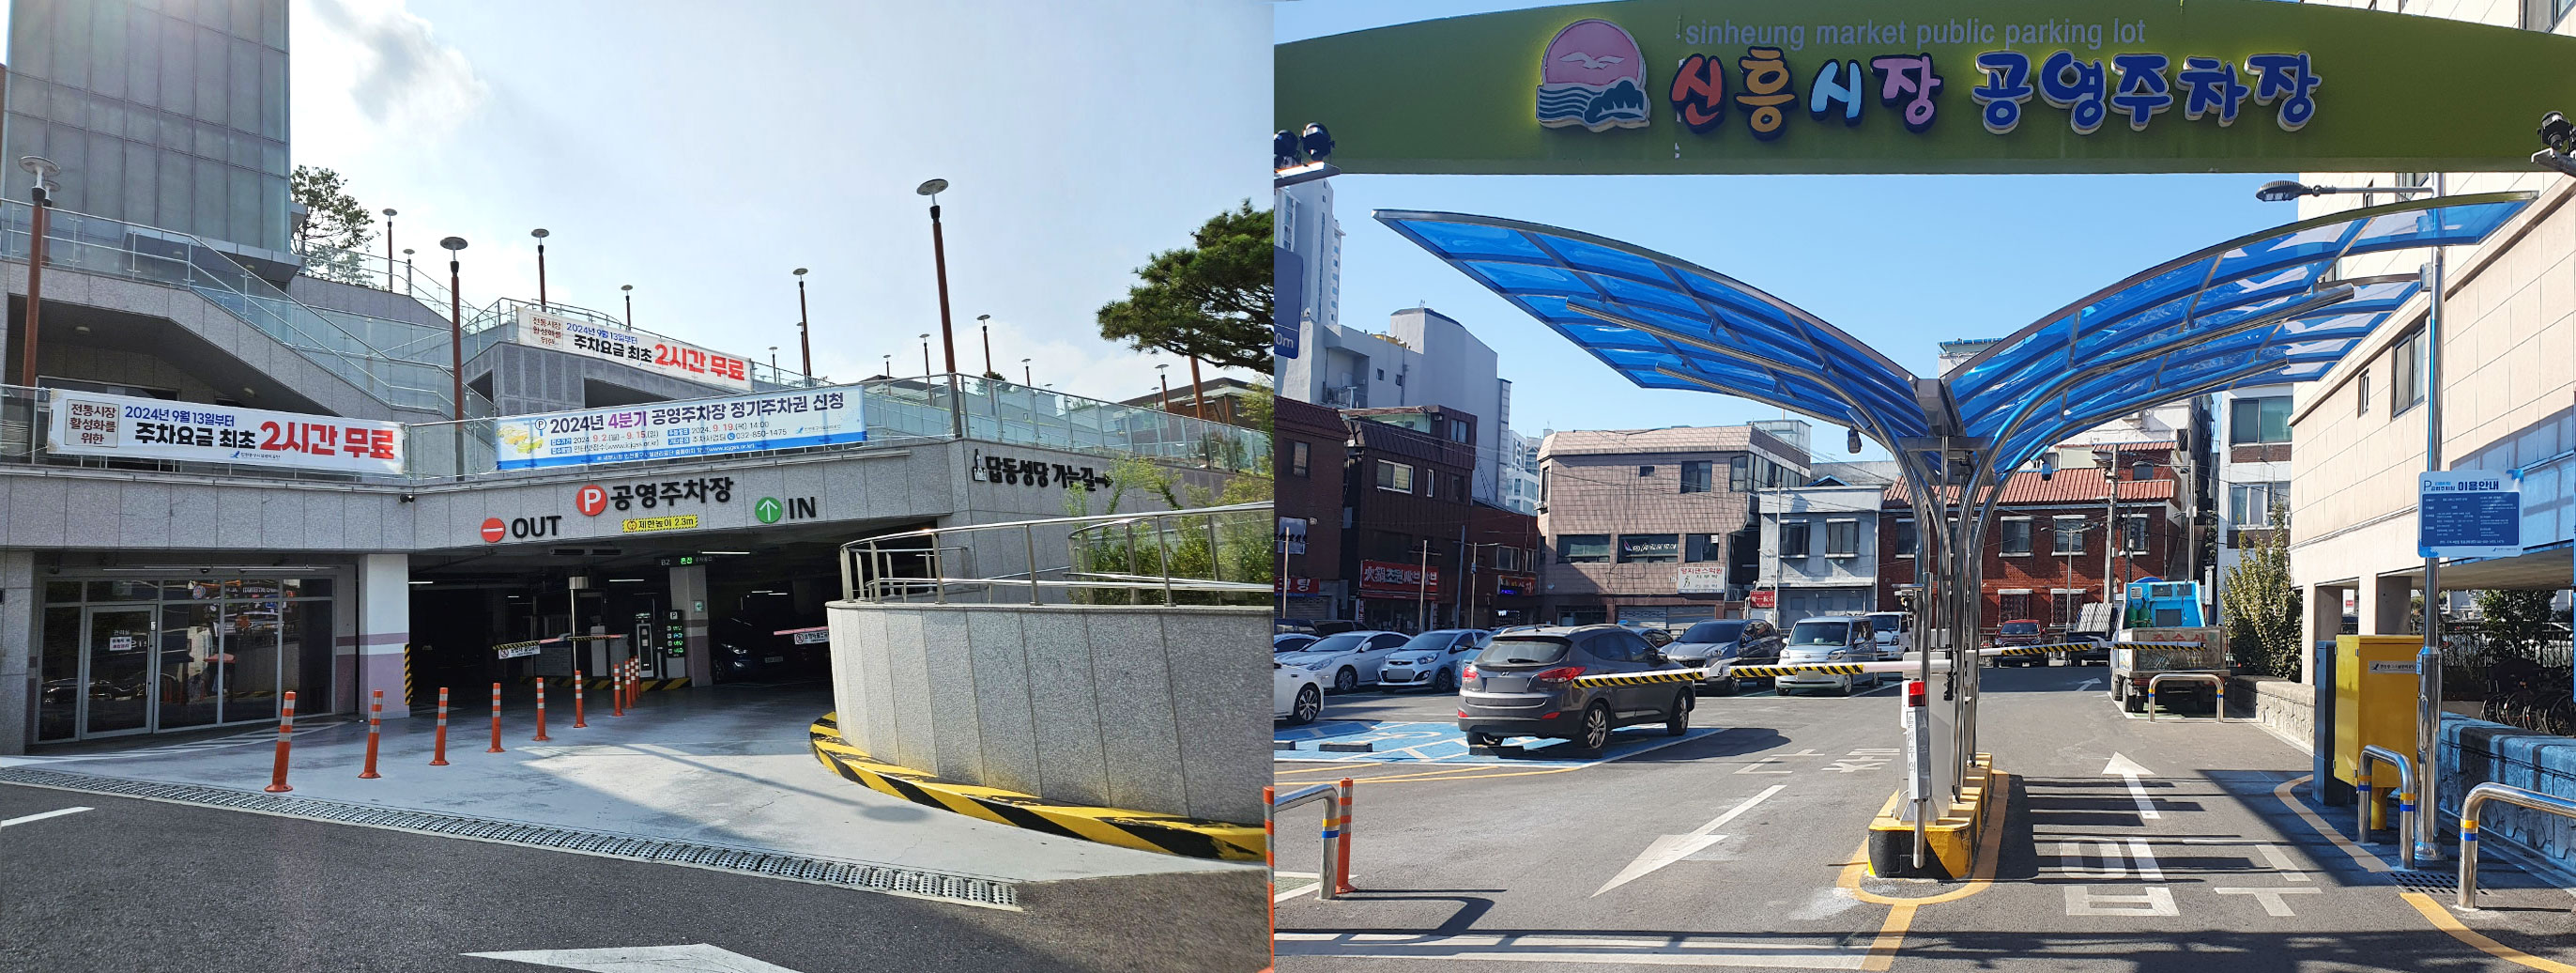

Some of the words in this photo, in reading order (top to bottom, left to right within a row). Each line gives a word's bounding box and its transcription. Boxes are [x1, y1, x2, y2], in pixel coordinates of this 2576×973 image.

[1685, 19, 1805, 51] sinheung
[1816, 20, 1907, 45] market
[1916, 19, 1995, 50] public
[2005, 18, 2103, 50] parking
[2113, 18, 2146, 43] lot
[1670, 47, 1943, 141] 신흥시장
[1972, 50, 2322, 134] 공영주차장
[532, 317, 561, 331] 전통시장
[566, 322, 595, 336] 2024년
[610, 332, 638, 345] 13일부터
[574, 333, 625, 357] 주차요금
[628, 345, 652, 363] 최초
[654, 343, 706, 374] 2시간
[711, 354, 744, 381] 무료
[70, 404, 116, 419] 전통시장
[125, 406, 169, 421] 2024년
[173, 410, 191, 423] 9월
[192, 412, 235, 427] 13일부터
[550, 415, 604, 434] 2024년
[607, 410, 647, 429] 4분기
[652, 405, 727, 425] 공영주차장
[730, 396, 808, 418] 정기주차권
[813, 392, 844, 410] 신청
[69, 418, 116, 432] 활성화를
[736, 428, 788, 439] 032-850-1475
[750, 421, 769, 429] 14:00
[81, 433, 104, 444] 위한
[135, 422, 214, 448] 주차요금
[219, 428, 255, 450] 최초
[260, 421, 338, 456] 2시간
[344, 427, 394, 459] 무료
[986, 456, 1050, 487] 답동성당
[1052, 463, 1096, 491] 가는길
[583, 488, 602, 513] P
[610, 477, 734, 512] 공영주차장
[2458, 480, 2499, 491] 이용안내
[788, 497, 817, 520] IN
[512, 516, 562, 539] OUT
[638, 518, 672, 529] 제한높이
[674, 517, 694, 526] 2.3m
[2060, 838, 2323, 916] 입구
